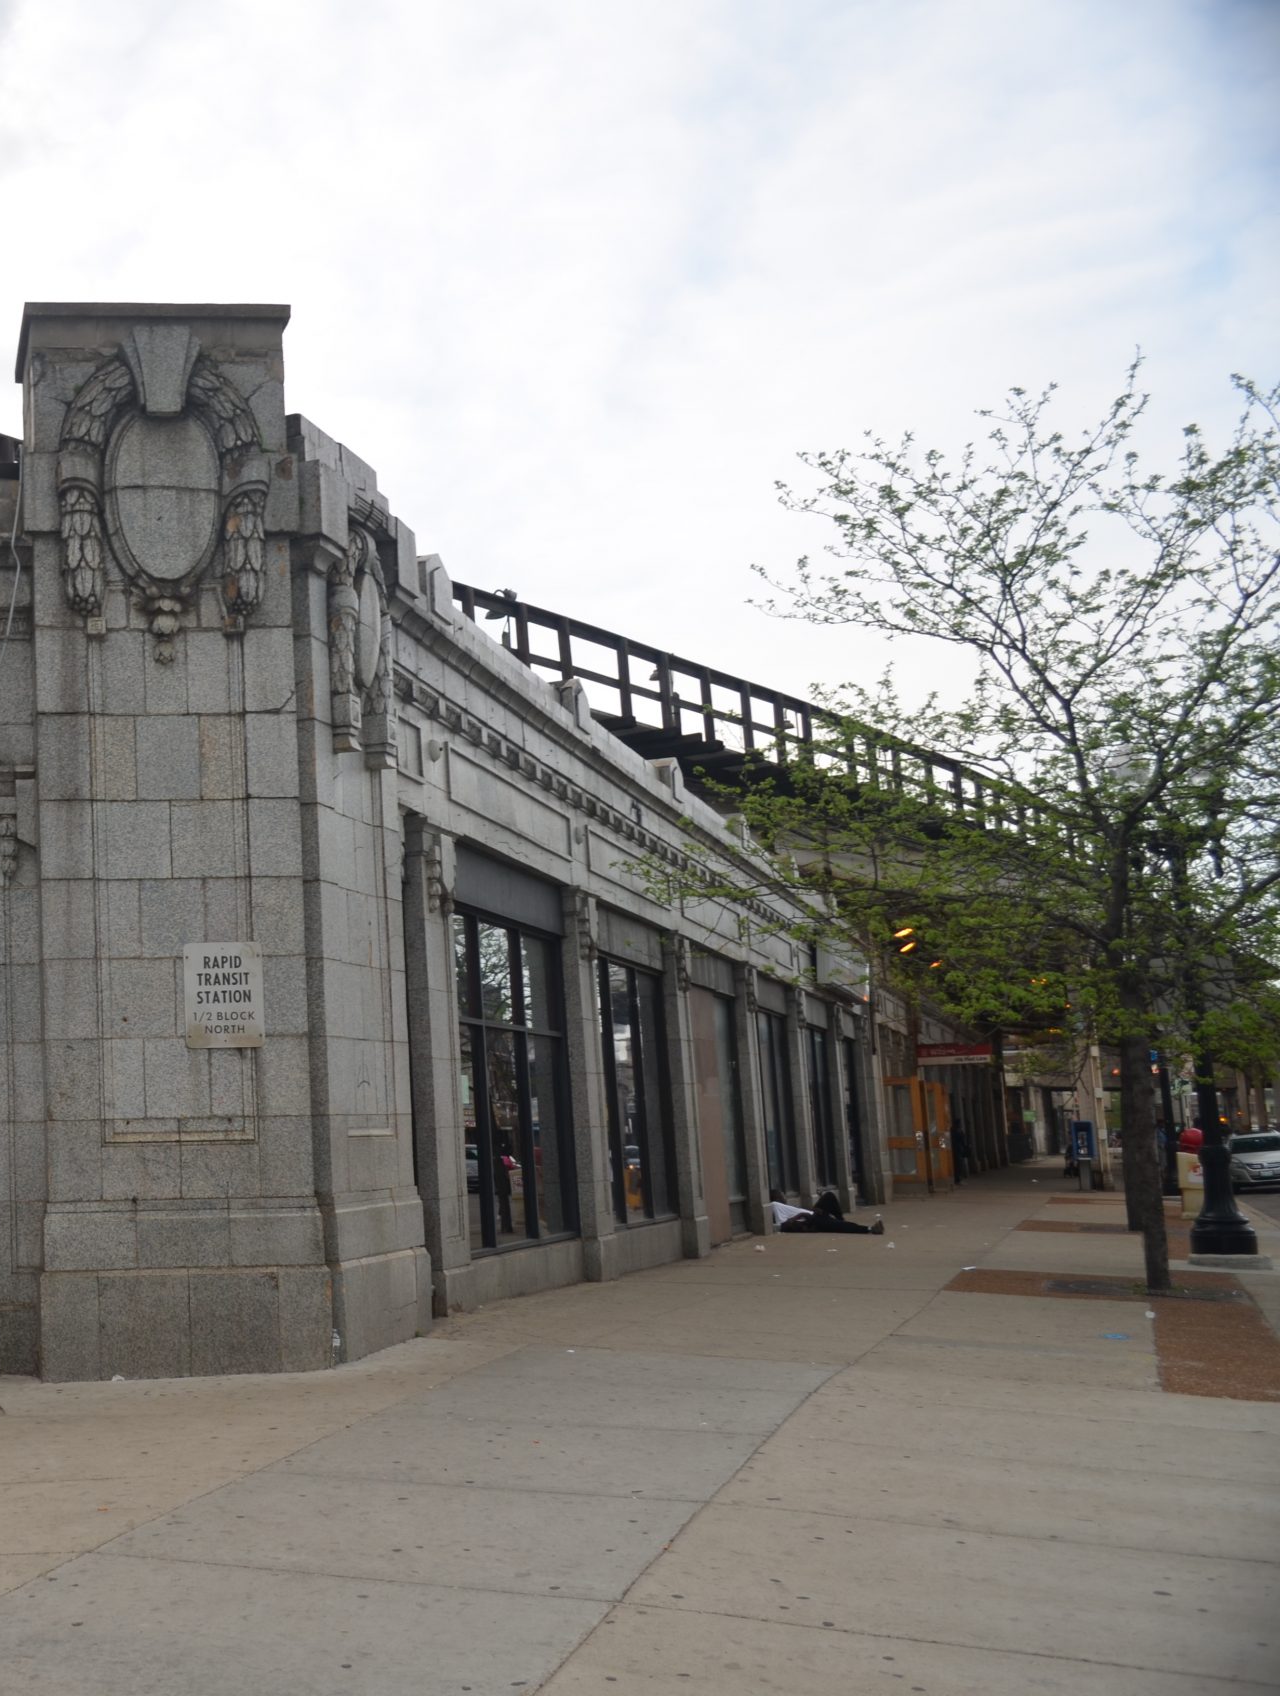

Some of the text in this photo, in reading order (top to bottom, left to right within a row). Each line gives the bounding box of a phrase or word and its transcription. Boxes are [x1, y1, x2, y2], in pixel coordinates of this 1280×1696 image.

[203, 955, 242, 969] RAPID
[196, 972, 250, 986] TRANSIT
[196, 989, 251, 1004] STATION
[193, 1011, 255, 1023] 1/2 BLOCK
[205, 1024, 245, 1034] NORTH
